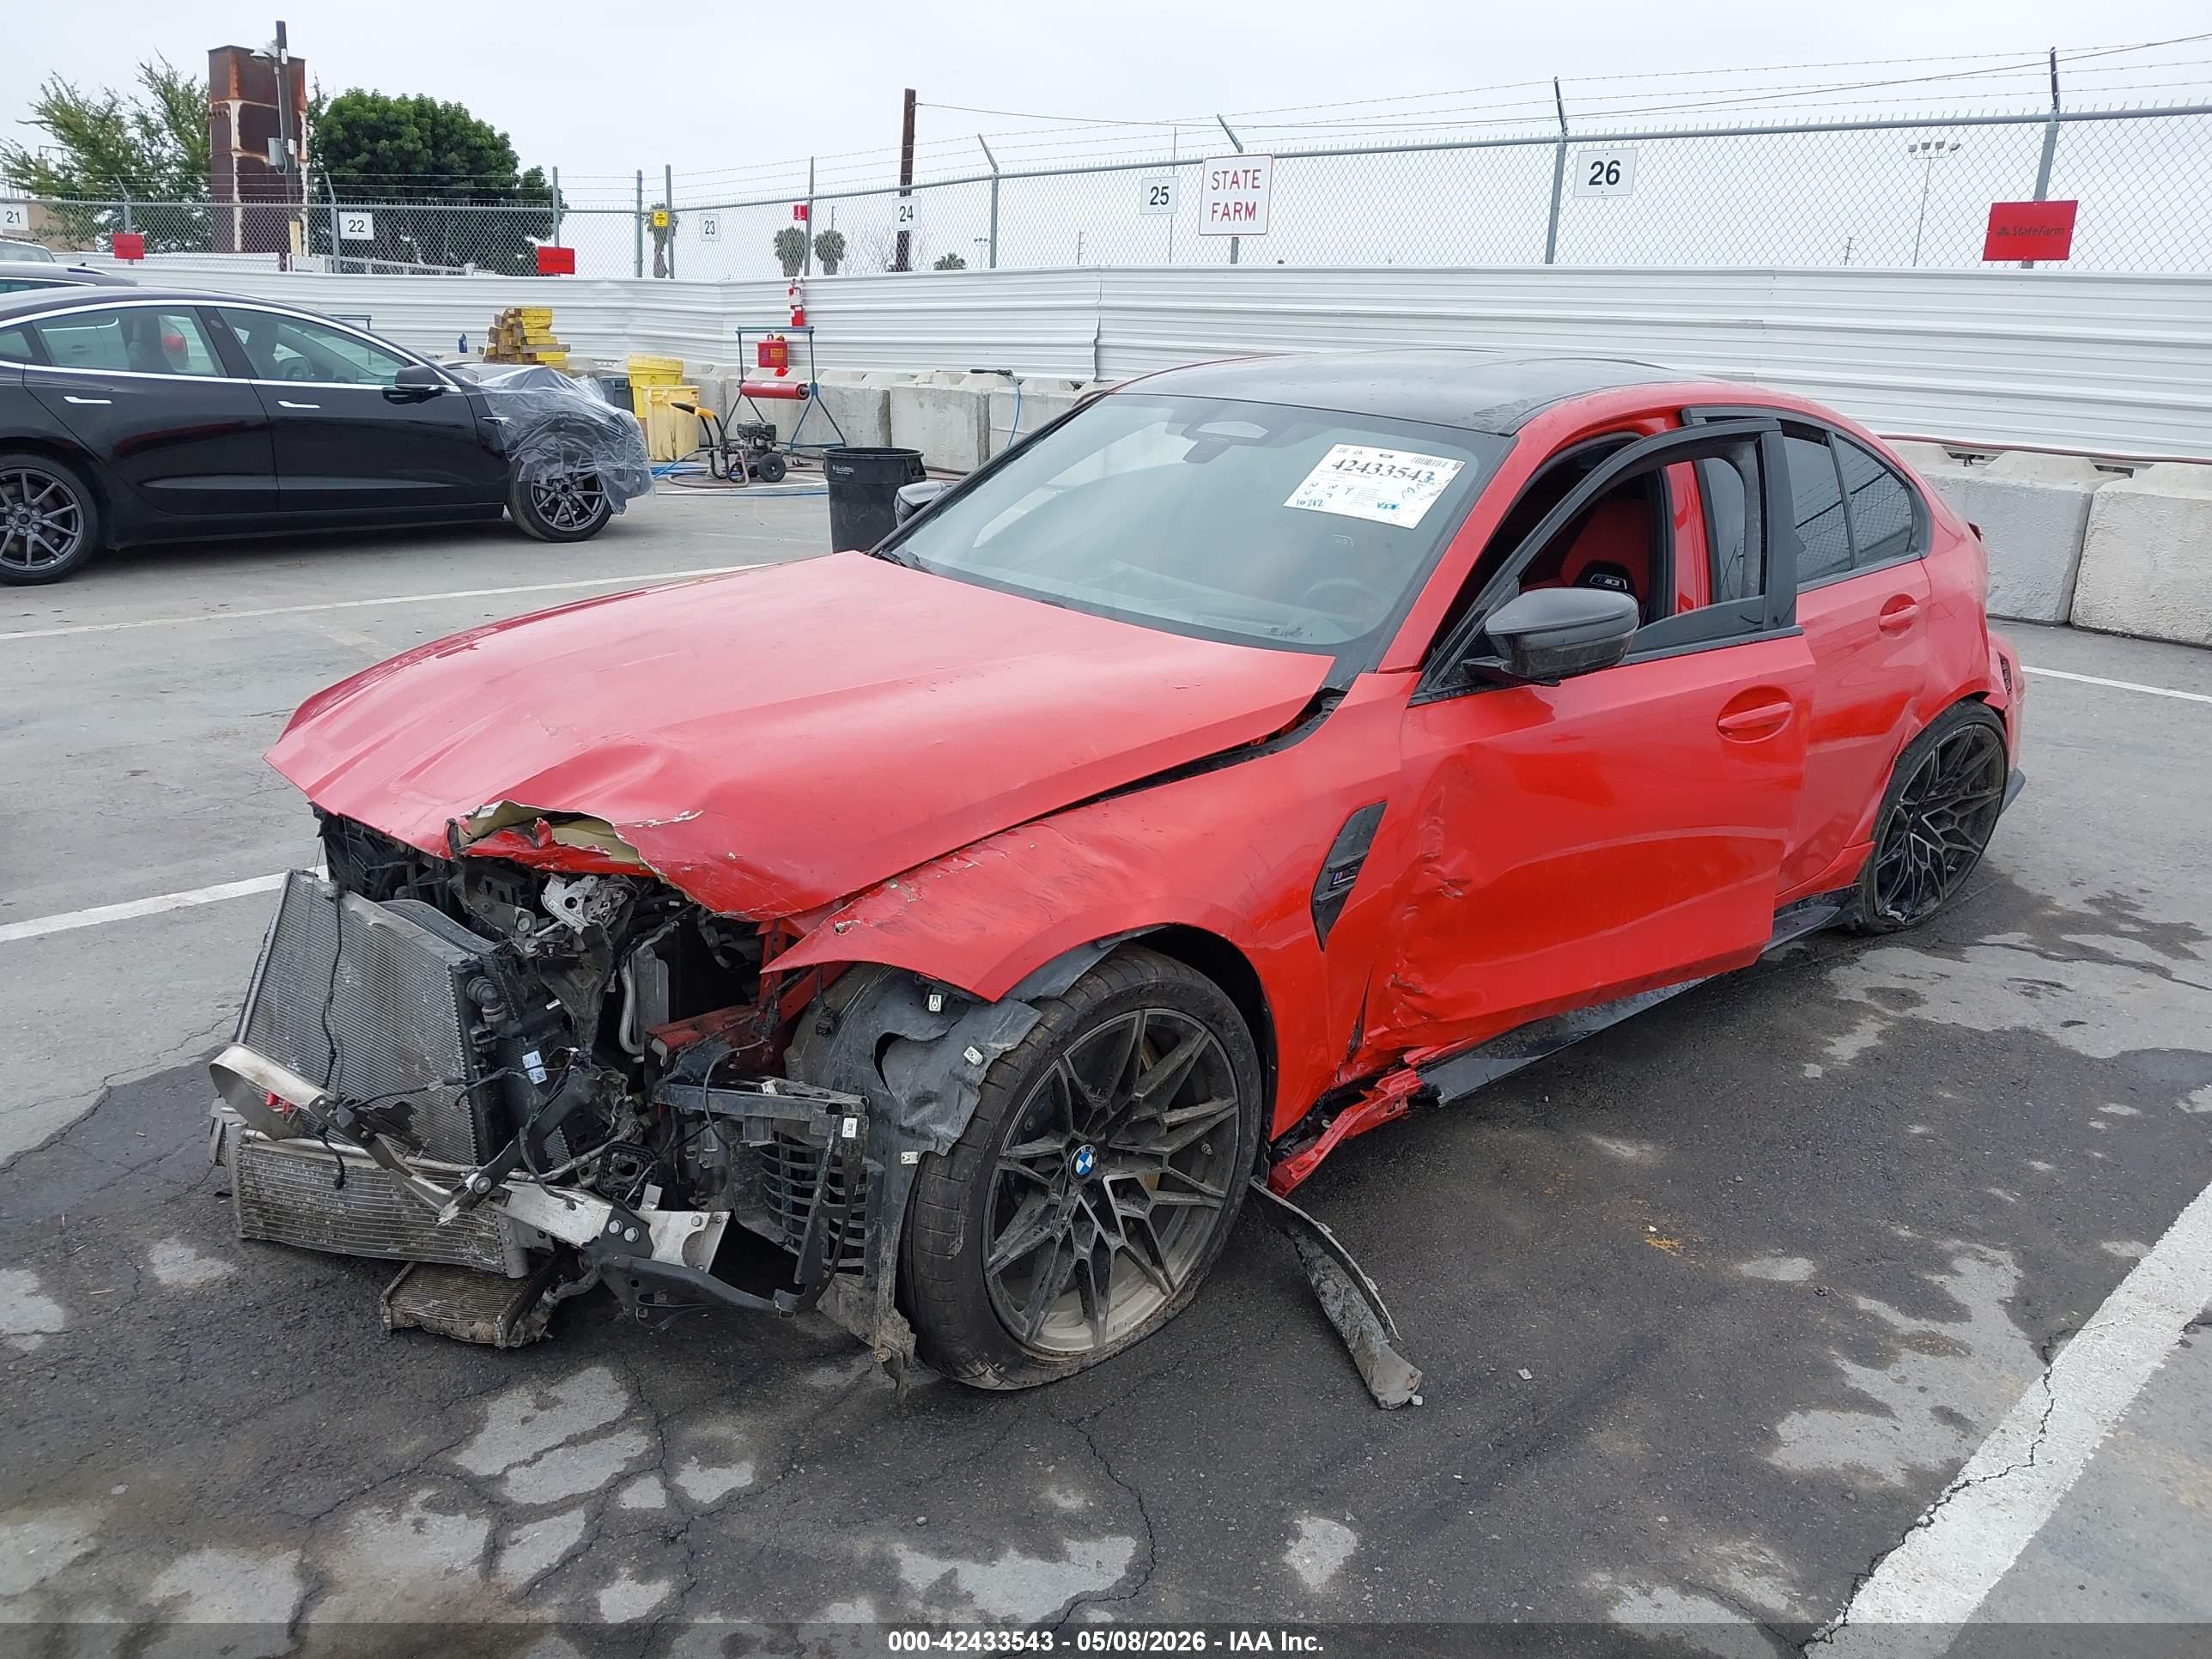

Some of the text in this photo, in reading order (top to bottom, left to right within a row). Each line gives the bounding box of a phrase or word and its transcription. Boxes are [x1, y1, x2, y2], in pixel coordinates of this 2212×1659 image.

[1211, 169, 1261, 191] STATE
[1589, 160, 1621, 185] 26
[1150, 185, 1170, 206] 25
[6, 210, 21, 224] 21
[899, 205, 914, 222] 24
[1211, 201, 1257, 222] FARM
[348, 219, 366, 233] 22
[704, 220, 716, 235] 23
[1332, 459, 1435, 483] 42433543
